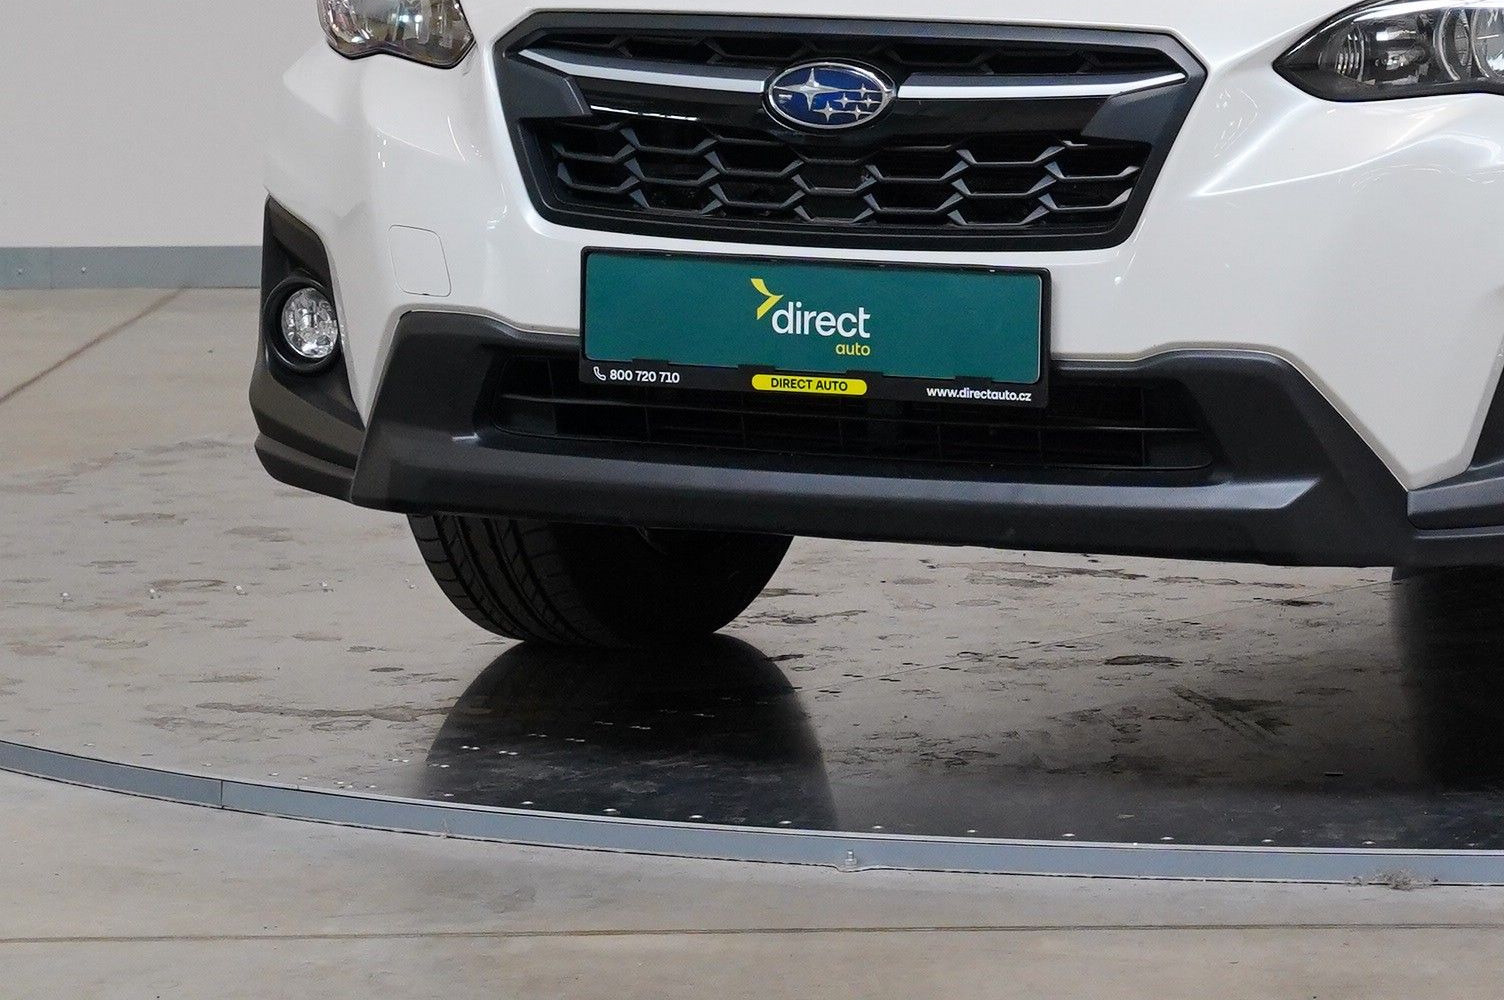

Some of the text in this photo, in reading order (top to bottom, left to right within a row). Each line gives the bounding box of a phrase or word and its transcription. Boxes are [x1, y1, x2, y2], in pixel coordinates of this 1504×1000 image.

[771, 301, 871, 338] direct
[835, 342, 871, 356] auto
[609, 369, 680, 383] 800 720 710
[770, 377, 848, 392] DIRECT AUTO
[926, 387, 1032, 401] www.directauto.cz
